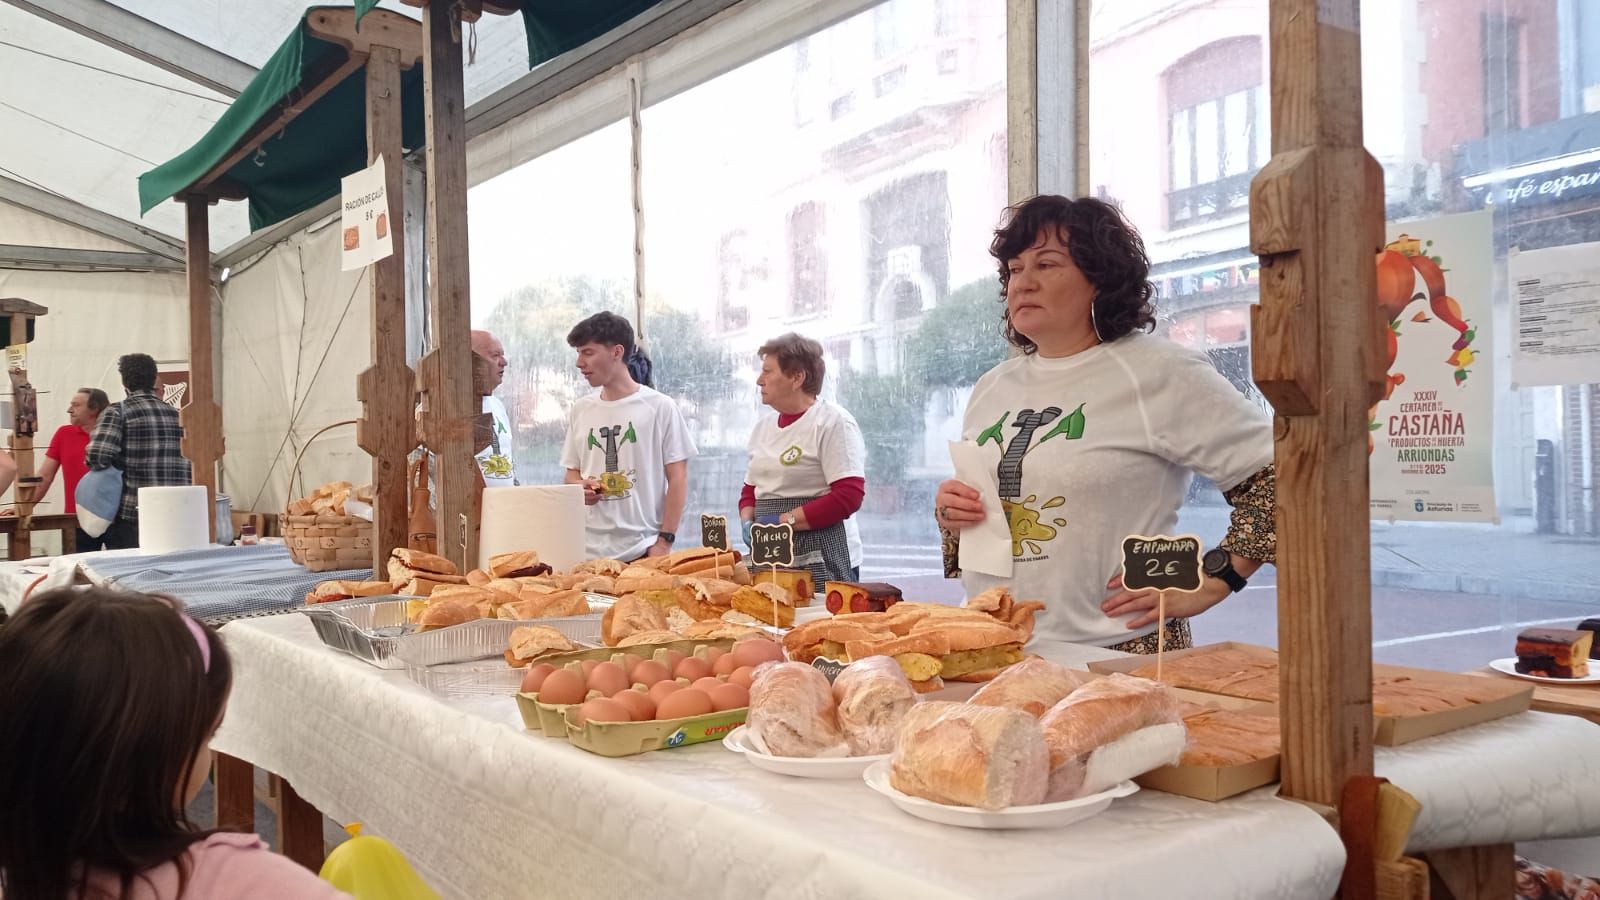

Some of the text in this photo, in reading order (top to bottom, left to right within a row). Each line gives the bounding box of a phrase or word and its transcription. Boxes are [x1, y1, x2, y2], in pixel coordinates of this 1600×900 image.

[1413, 390, 1438, 401] XXXIV
[1400, 401, 1437, 413] CERTAMEN
[1388, 410, 1465, 437] CASTAÑA
[1390, 438, 1431, 448] PRODUCTOS
[1437, 436, 1465, 447] HUERTA
[1397, 448, 1455, 462] ARRIONDAS
[1425, 464, 1447, 475] 2025
[764, 546, 781, 558] 2€
[1132, 541, 1195, 554] EMPANADA
[1145, 558, 1180, 577] 2€
